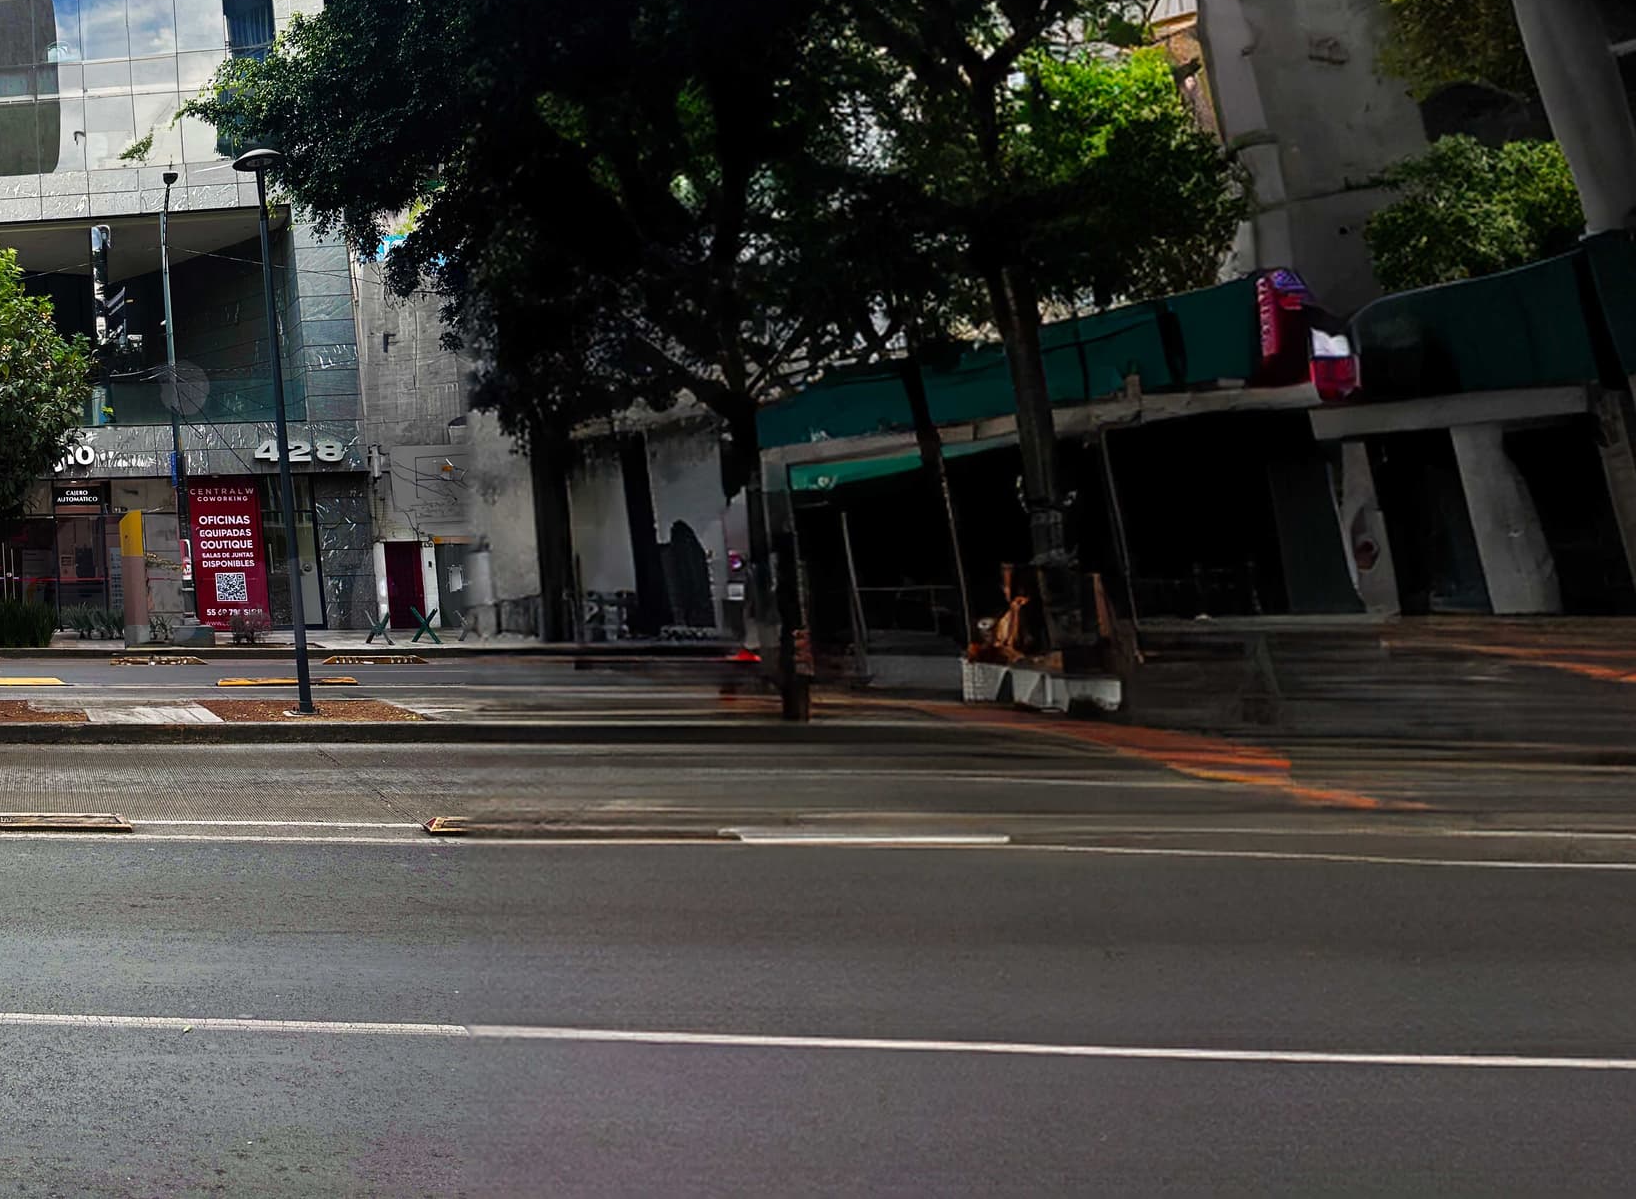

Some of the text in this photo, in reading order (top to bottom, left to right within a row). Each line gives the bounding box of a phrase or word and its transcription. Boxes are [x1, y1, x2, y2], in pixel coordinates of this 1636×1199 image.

[254, 440, 345, 462] 428
[199, 515, 251, 525] OFICINAS
[199, 529, 252, 537] EQUIPADAS
[202, 560, 255, 568] DISPONIBLES
[206, 608, 216, 616] 55
